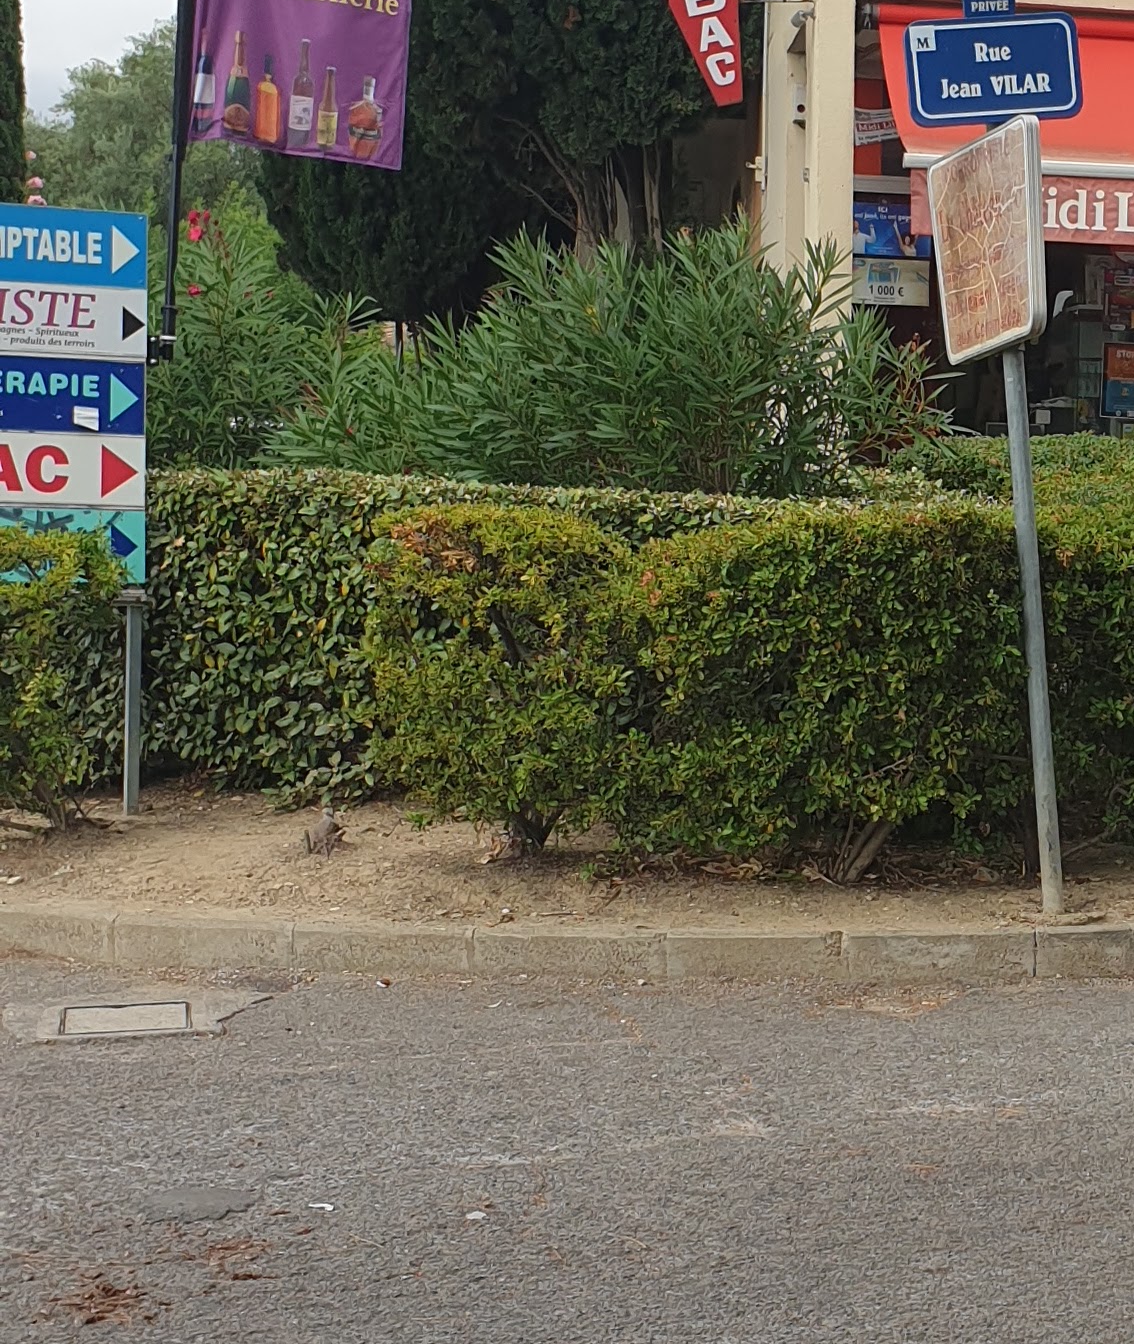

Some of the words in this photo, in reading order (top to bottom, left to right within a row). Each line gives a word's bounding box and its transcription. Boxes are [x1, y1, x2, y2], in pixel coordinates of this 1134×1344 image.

[916, 37, 931, 49] M
[974, 42, 1012, 63] Rue
[941, 78, 982, 100] Jean
[990, 73, 1051, 96] VILAR
[1041, 186, 1108, 231] idi
[877, 285, 895, 296] 000
[35, 326, 80, 337] Spiritueux
[10, 336, 46, 346] produits
[48, 337, 62, 346] des
[64, 338, 96, 348] terroirs
